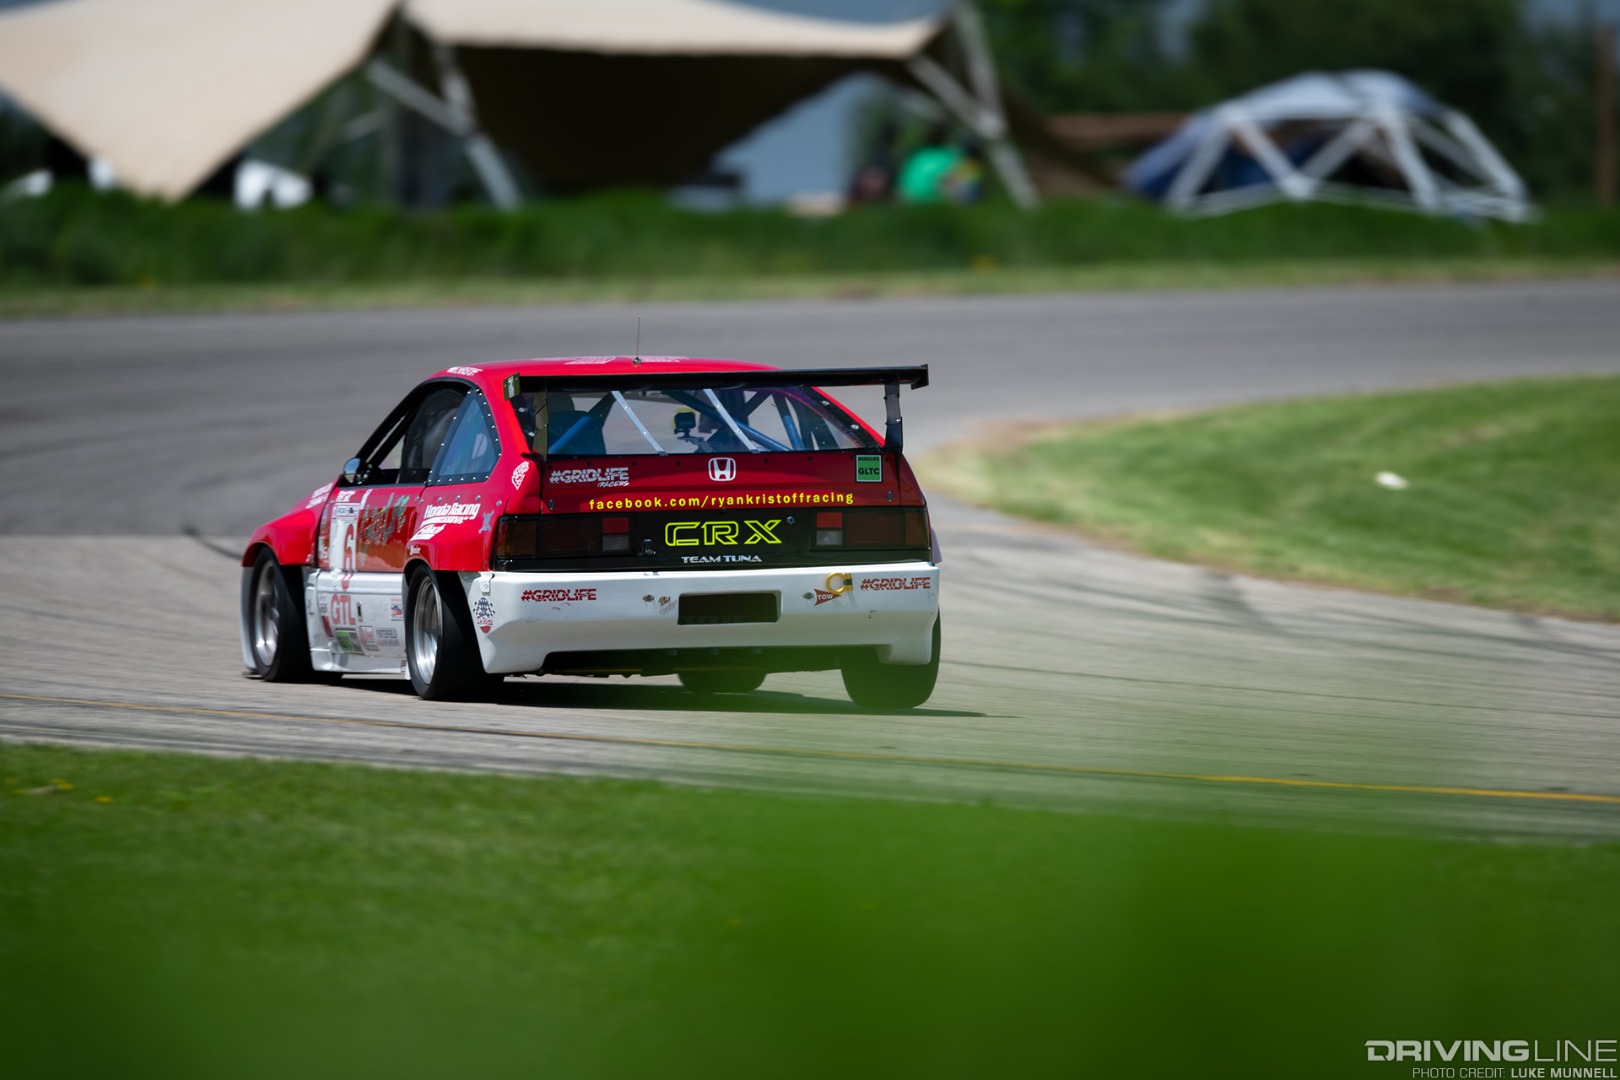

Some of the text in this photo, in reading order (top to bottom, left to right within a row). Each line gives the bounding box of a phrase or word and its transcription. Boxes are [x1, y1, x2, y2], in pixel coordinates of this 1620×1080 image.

[549, 467, 629, 484] #GRIDLIFE
[858, 467, 880, 475] GLTC
[589, 492, 854, 510] facebook.com/ryankristoffracing
[424, 503, 451, 519] Honda
[450, 502, 481, 520] Racing
[665, 519, 783, 547] CRX
[681, 555, 763, 564] TEAM TUNA
[860, 577, 931, 591] #GRIDLIFE
[521, 589, 597, 602] #GRIDLIFE
[330, 593, 356, 625] GTL
